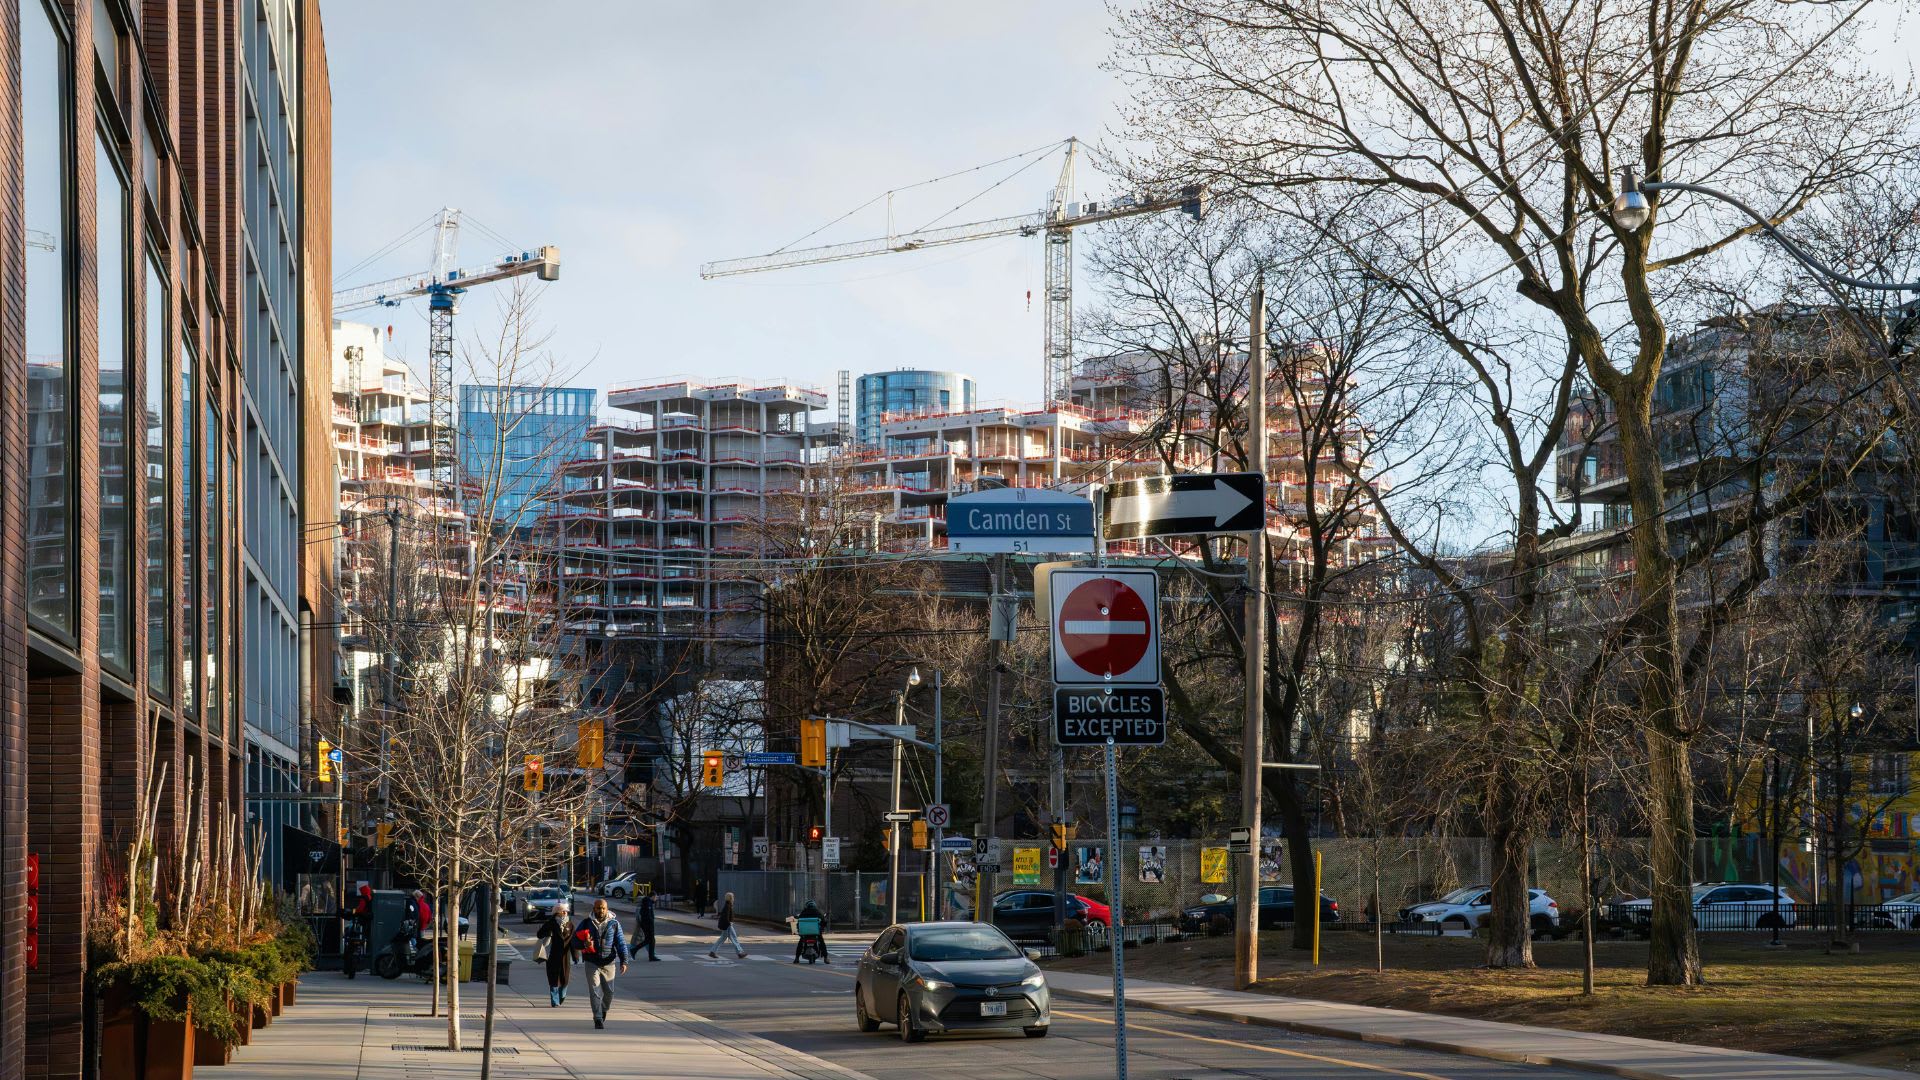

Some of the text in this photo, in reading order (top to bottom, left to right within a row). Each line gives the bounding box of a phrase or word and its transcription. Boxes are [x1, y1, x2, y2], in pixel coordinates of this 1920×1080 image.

[969, 509, 1071, 531] Camden St
[1013, 540, 1029, 552] 51
[1069, 696, 1151, 713] BICYCLES
[1065, 719, 1157, 736] EXCEPTED
[754, 844, 768, 854] 30
